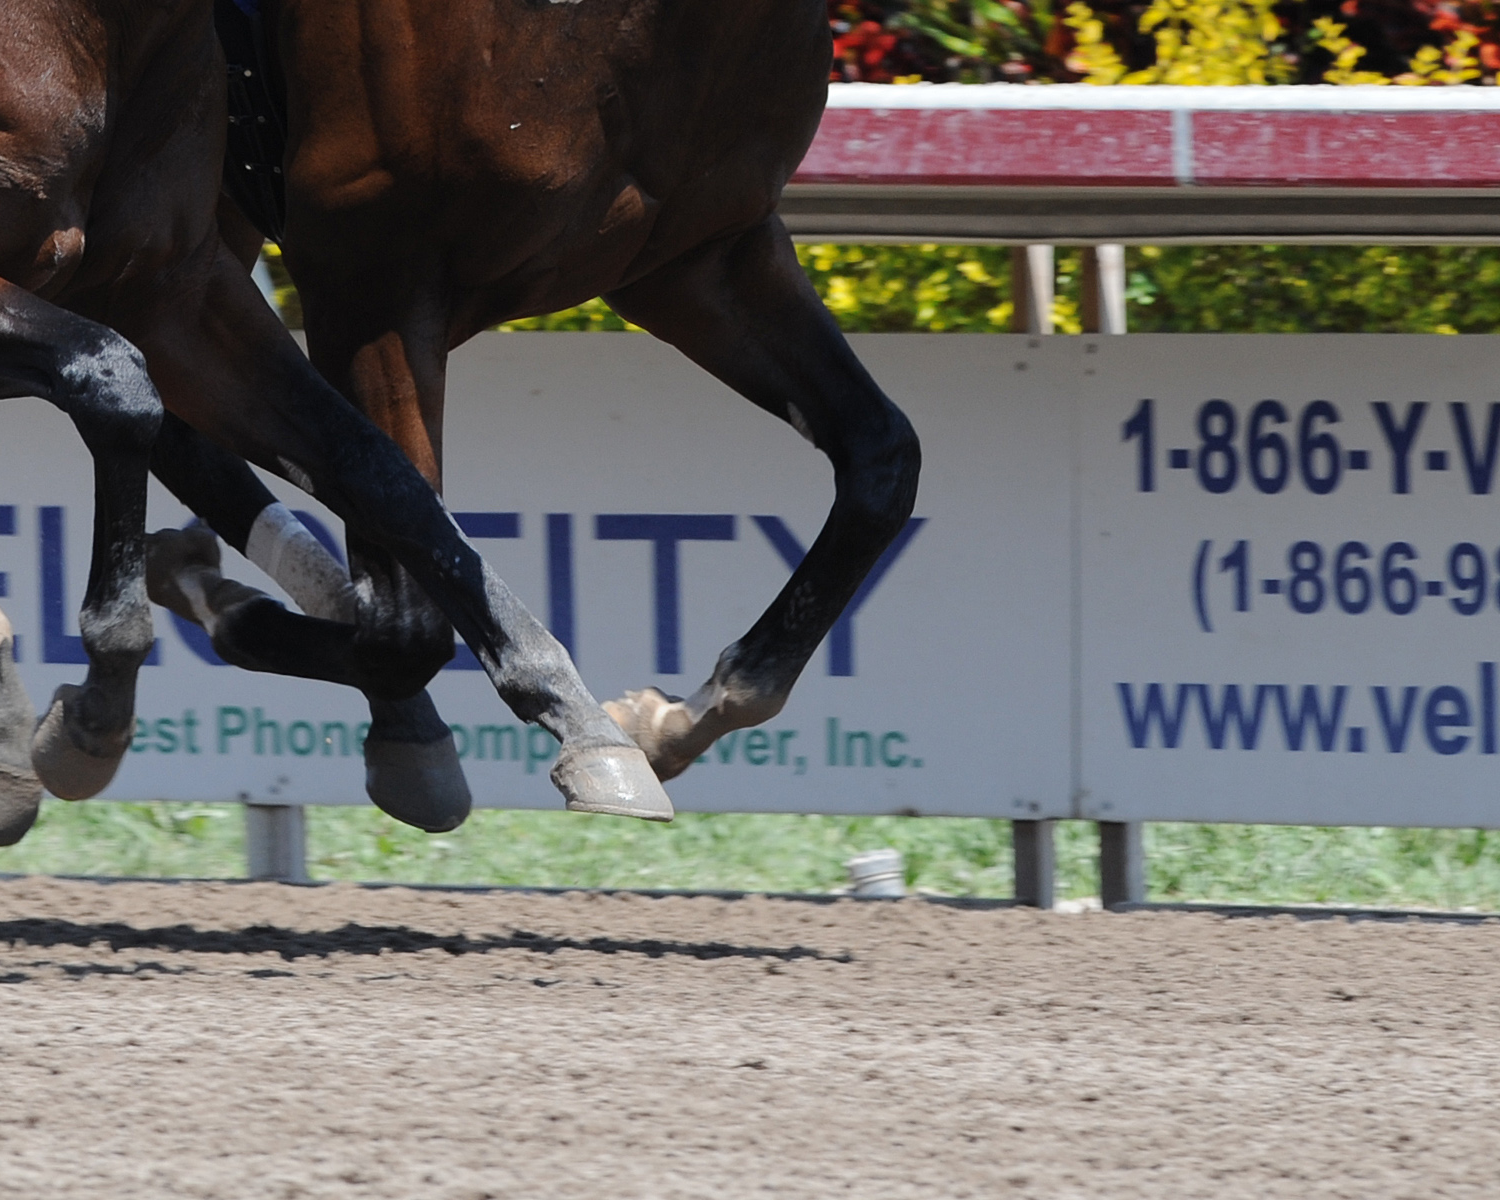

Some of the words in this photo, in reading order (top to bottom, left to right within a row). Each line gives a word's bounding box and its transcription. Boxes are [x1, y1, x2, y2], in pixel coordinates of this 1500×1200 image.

[1120, 398, 1500, 495] 1-866-Y-V
[1191, 539, 1500, 633] (1-866-9
[692, 727, 808, 776] ver,
[825, 716, 925, 768] Inc.
[1115, 661, 1500, 756] www.vel
